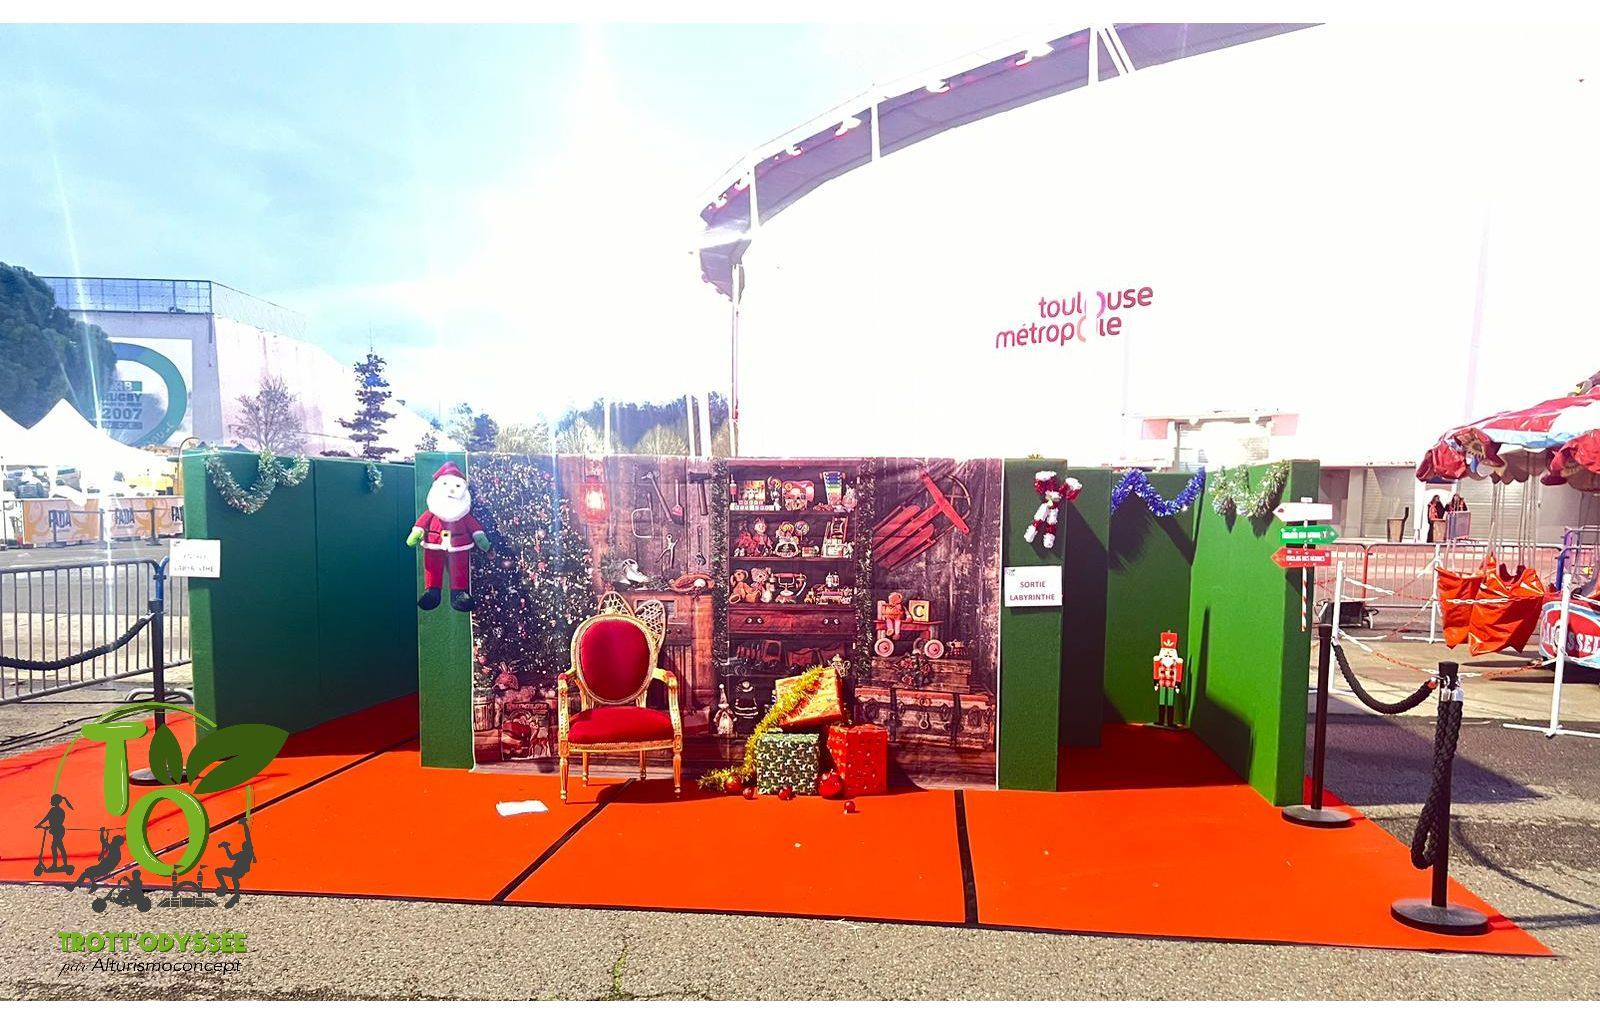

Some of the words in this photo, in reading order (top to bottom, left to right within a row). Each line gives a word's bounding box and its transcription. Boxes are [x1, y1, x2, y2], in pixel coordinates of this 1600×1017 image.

[102, 408, 143, 420] 2007
[1019, 581, 1046, 589] SORTIE
[1009, 593, 1056, 602] LABYRINTHE
[913, 604, 926, 618] C
